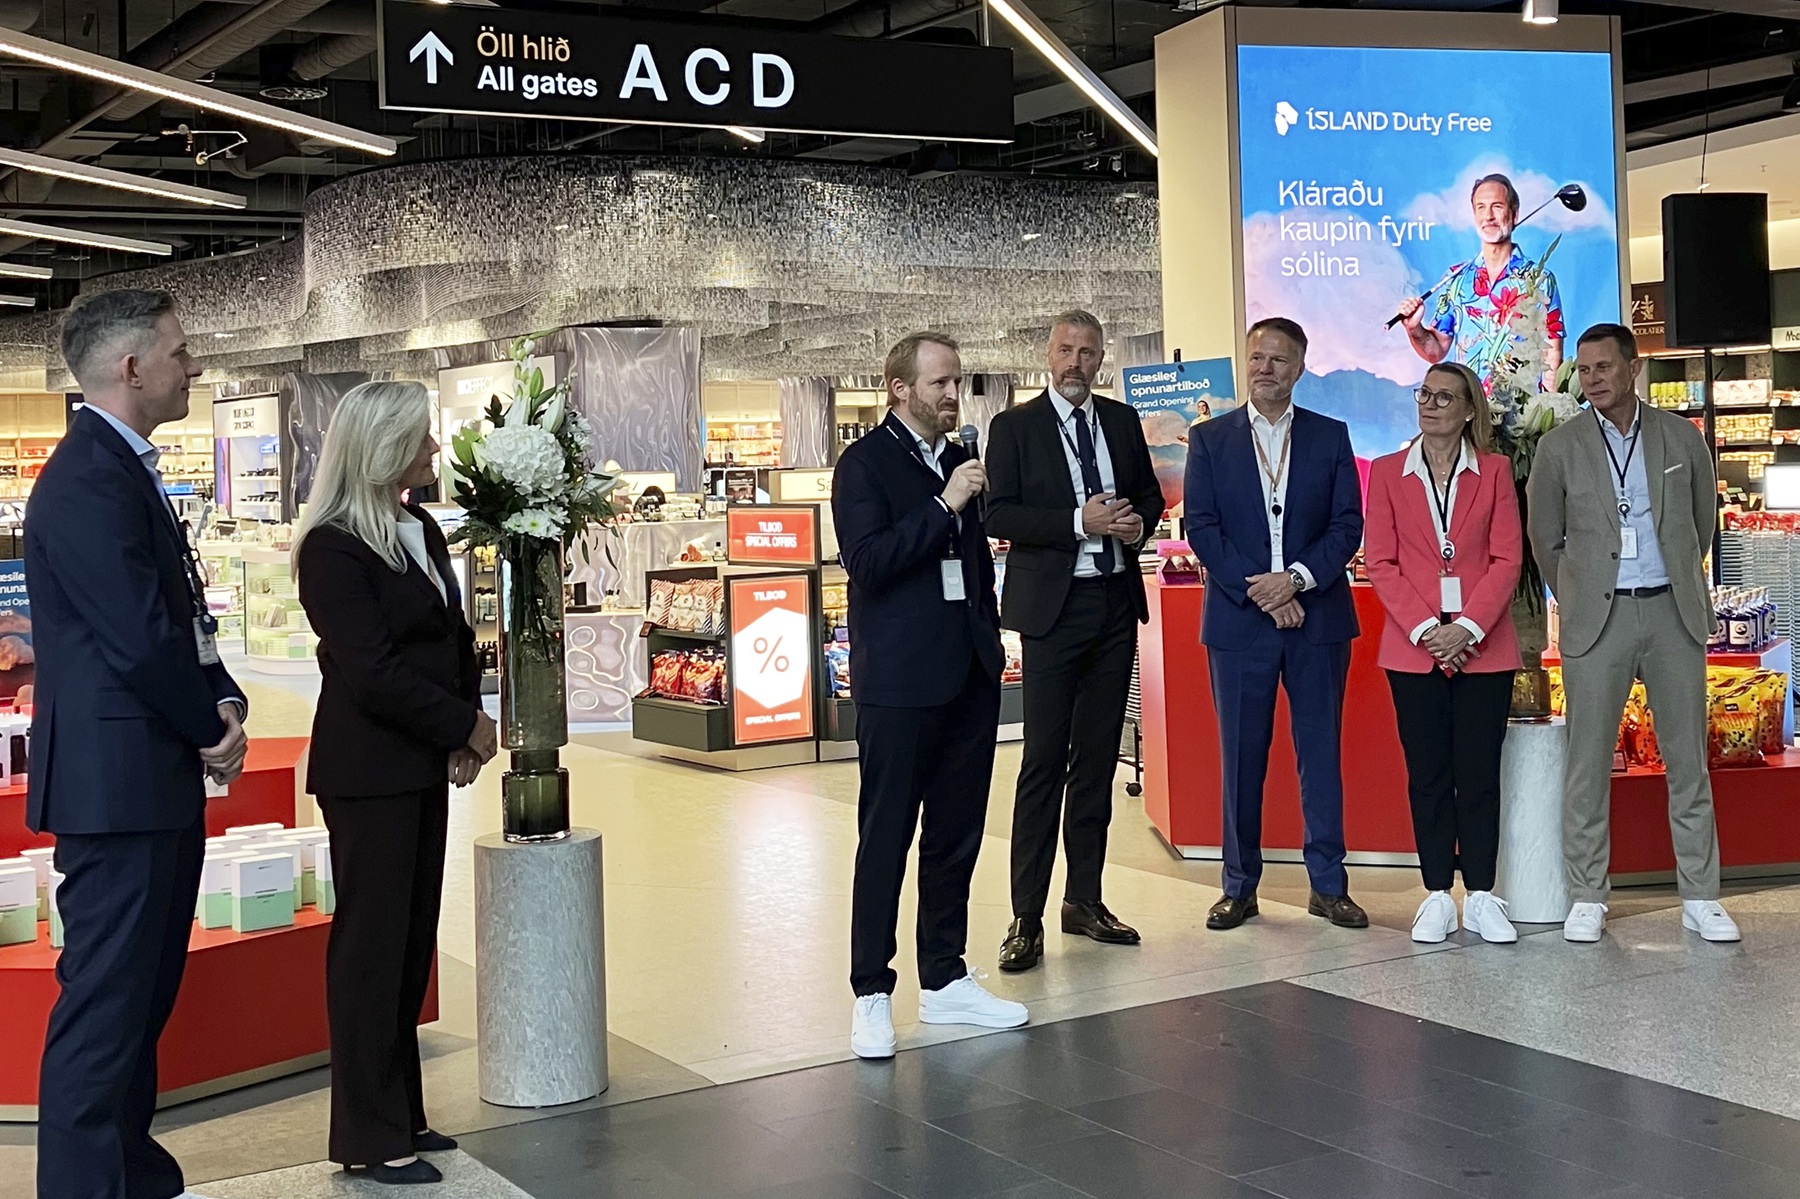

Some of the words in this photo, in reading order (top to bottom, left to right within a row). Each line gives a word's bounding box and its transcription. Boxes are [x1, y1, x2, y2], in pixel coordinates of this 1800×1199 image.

[476, 25, 514, 58] Öll
[523, 35, 571, 62] hlið
[477, 64, 514, 92] All
[521, 72, 598, 100] gates
[618, 43, 669, 102] A
[684, 47, 731, 106] C
[752, 52, 795, 108] D
[1305, 107, 1389, 131] ÍSLAND
[1393, 111, 1443, 136] Duty
[1447, 112, 1492, 132] Free
[1279, 179, 1383, 206] Kláraðu
[1280, 215, 1371, 247] kaupin
[1378, 215, 1436, 247] fyrir
[1281, 251, 1360, 277] sólina
[1129, 371, 1177, 384] Glæsileg
[1130, 378, 1211, 397] opnunartilboð
[1132, 400, 1159, 409] Grand
[1159, 396, 1194, 407] Opening
